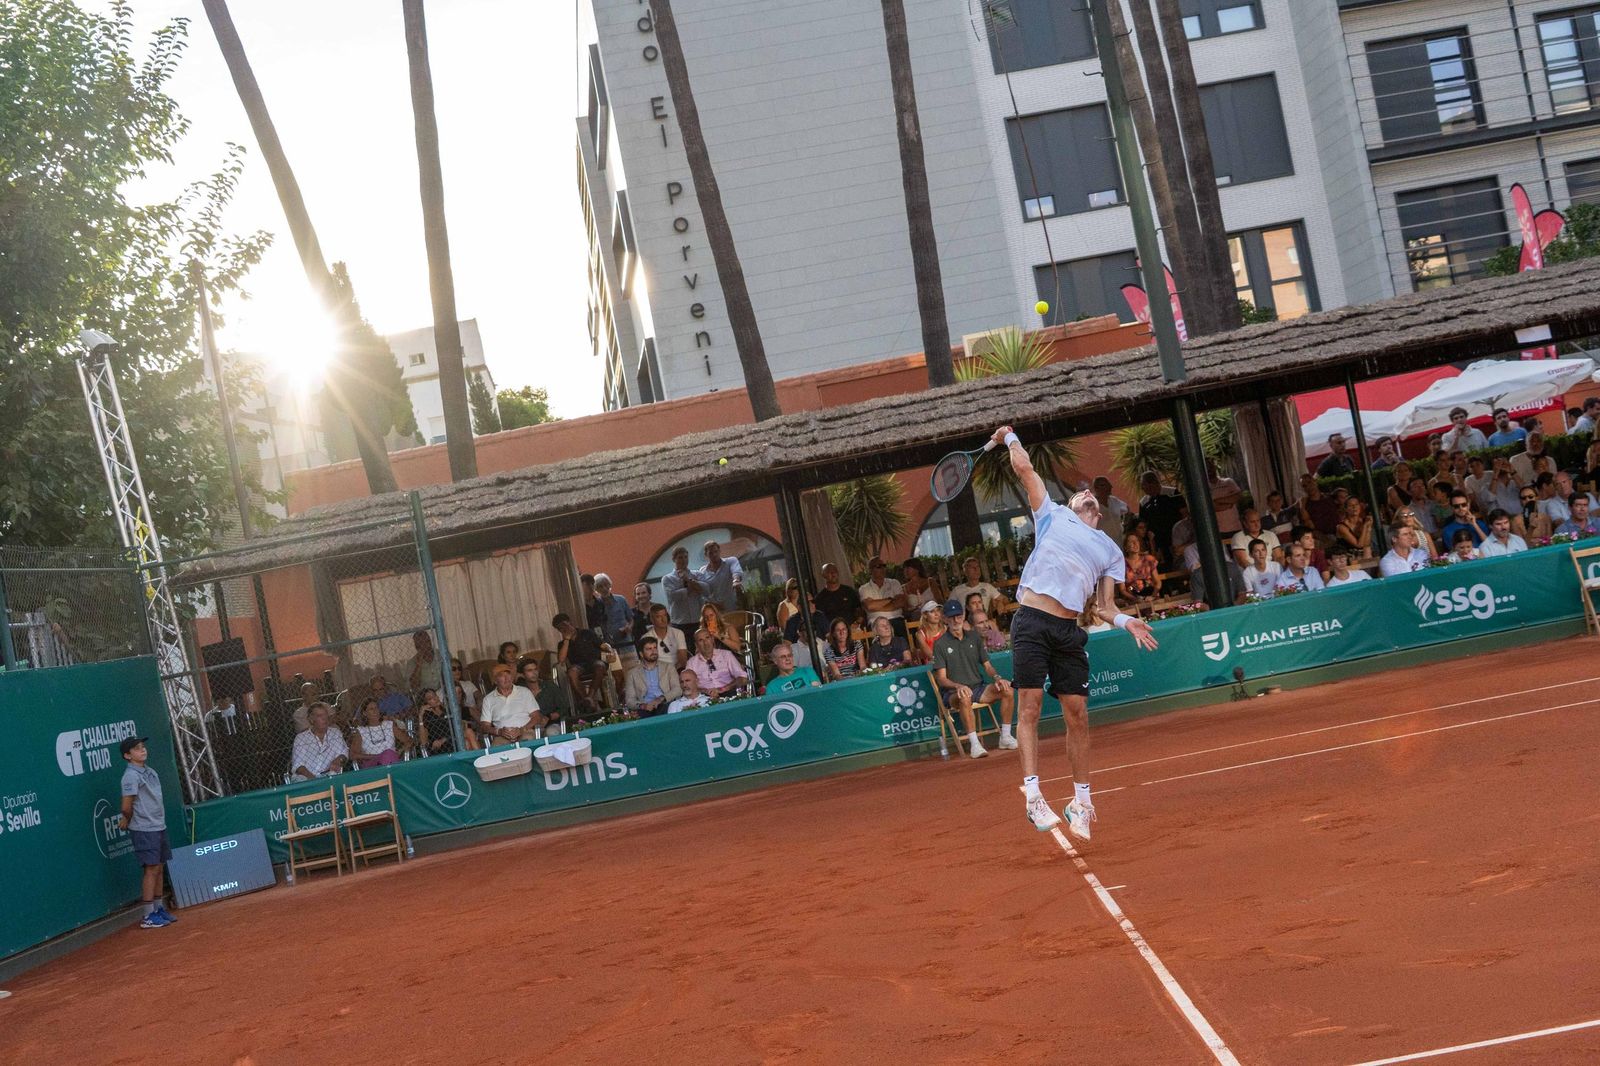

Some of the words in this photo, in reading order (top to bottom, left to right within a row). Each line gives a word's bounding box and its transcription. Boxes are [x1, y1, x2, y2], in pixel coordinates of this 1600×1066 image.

[637, 0, 658, 61] do
[650, 96, 668, 148] El
[666, 181, 718, 392] Porveni
[1236, 629, 1286, 648] JUAN
[1288, 619, 1343, 638] FERIA
[82, 720, 137, 750] CHALLENGER
[882, 715, 941, 736] PROCISA
[705, 723, 769, 759] FOX
[86, 747, 112, 772] TOUR
[748, 748, 771, 761] ESS
[6, 806, 41, 832] Sevilla
[195, 840, 238, 856] SPEED
[213, 881, 239, 892] KM/H
